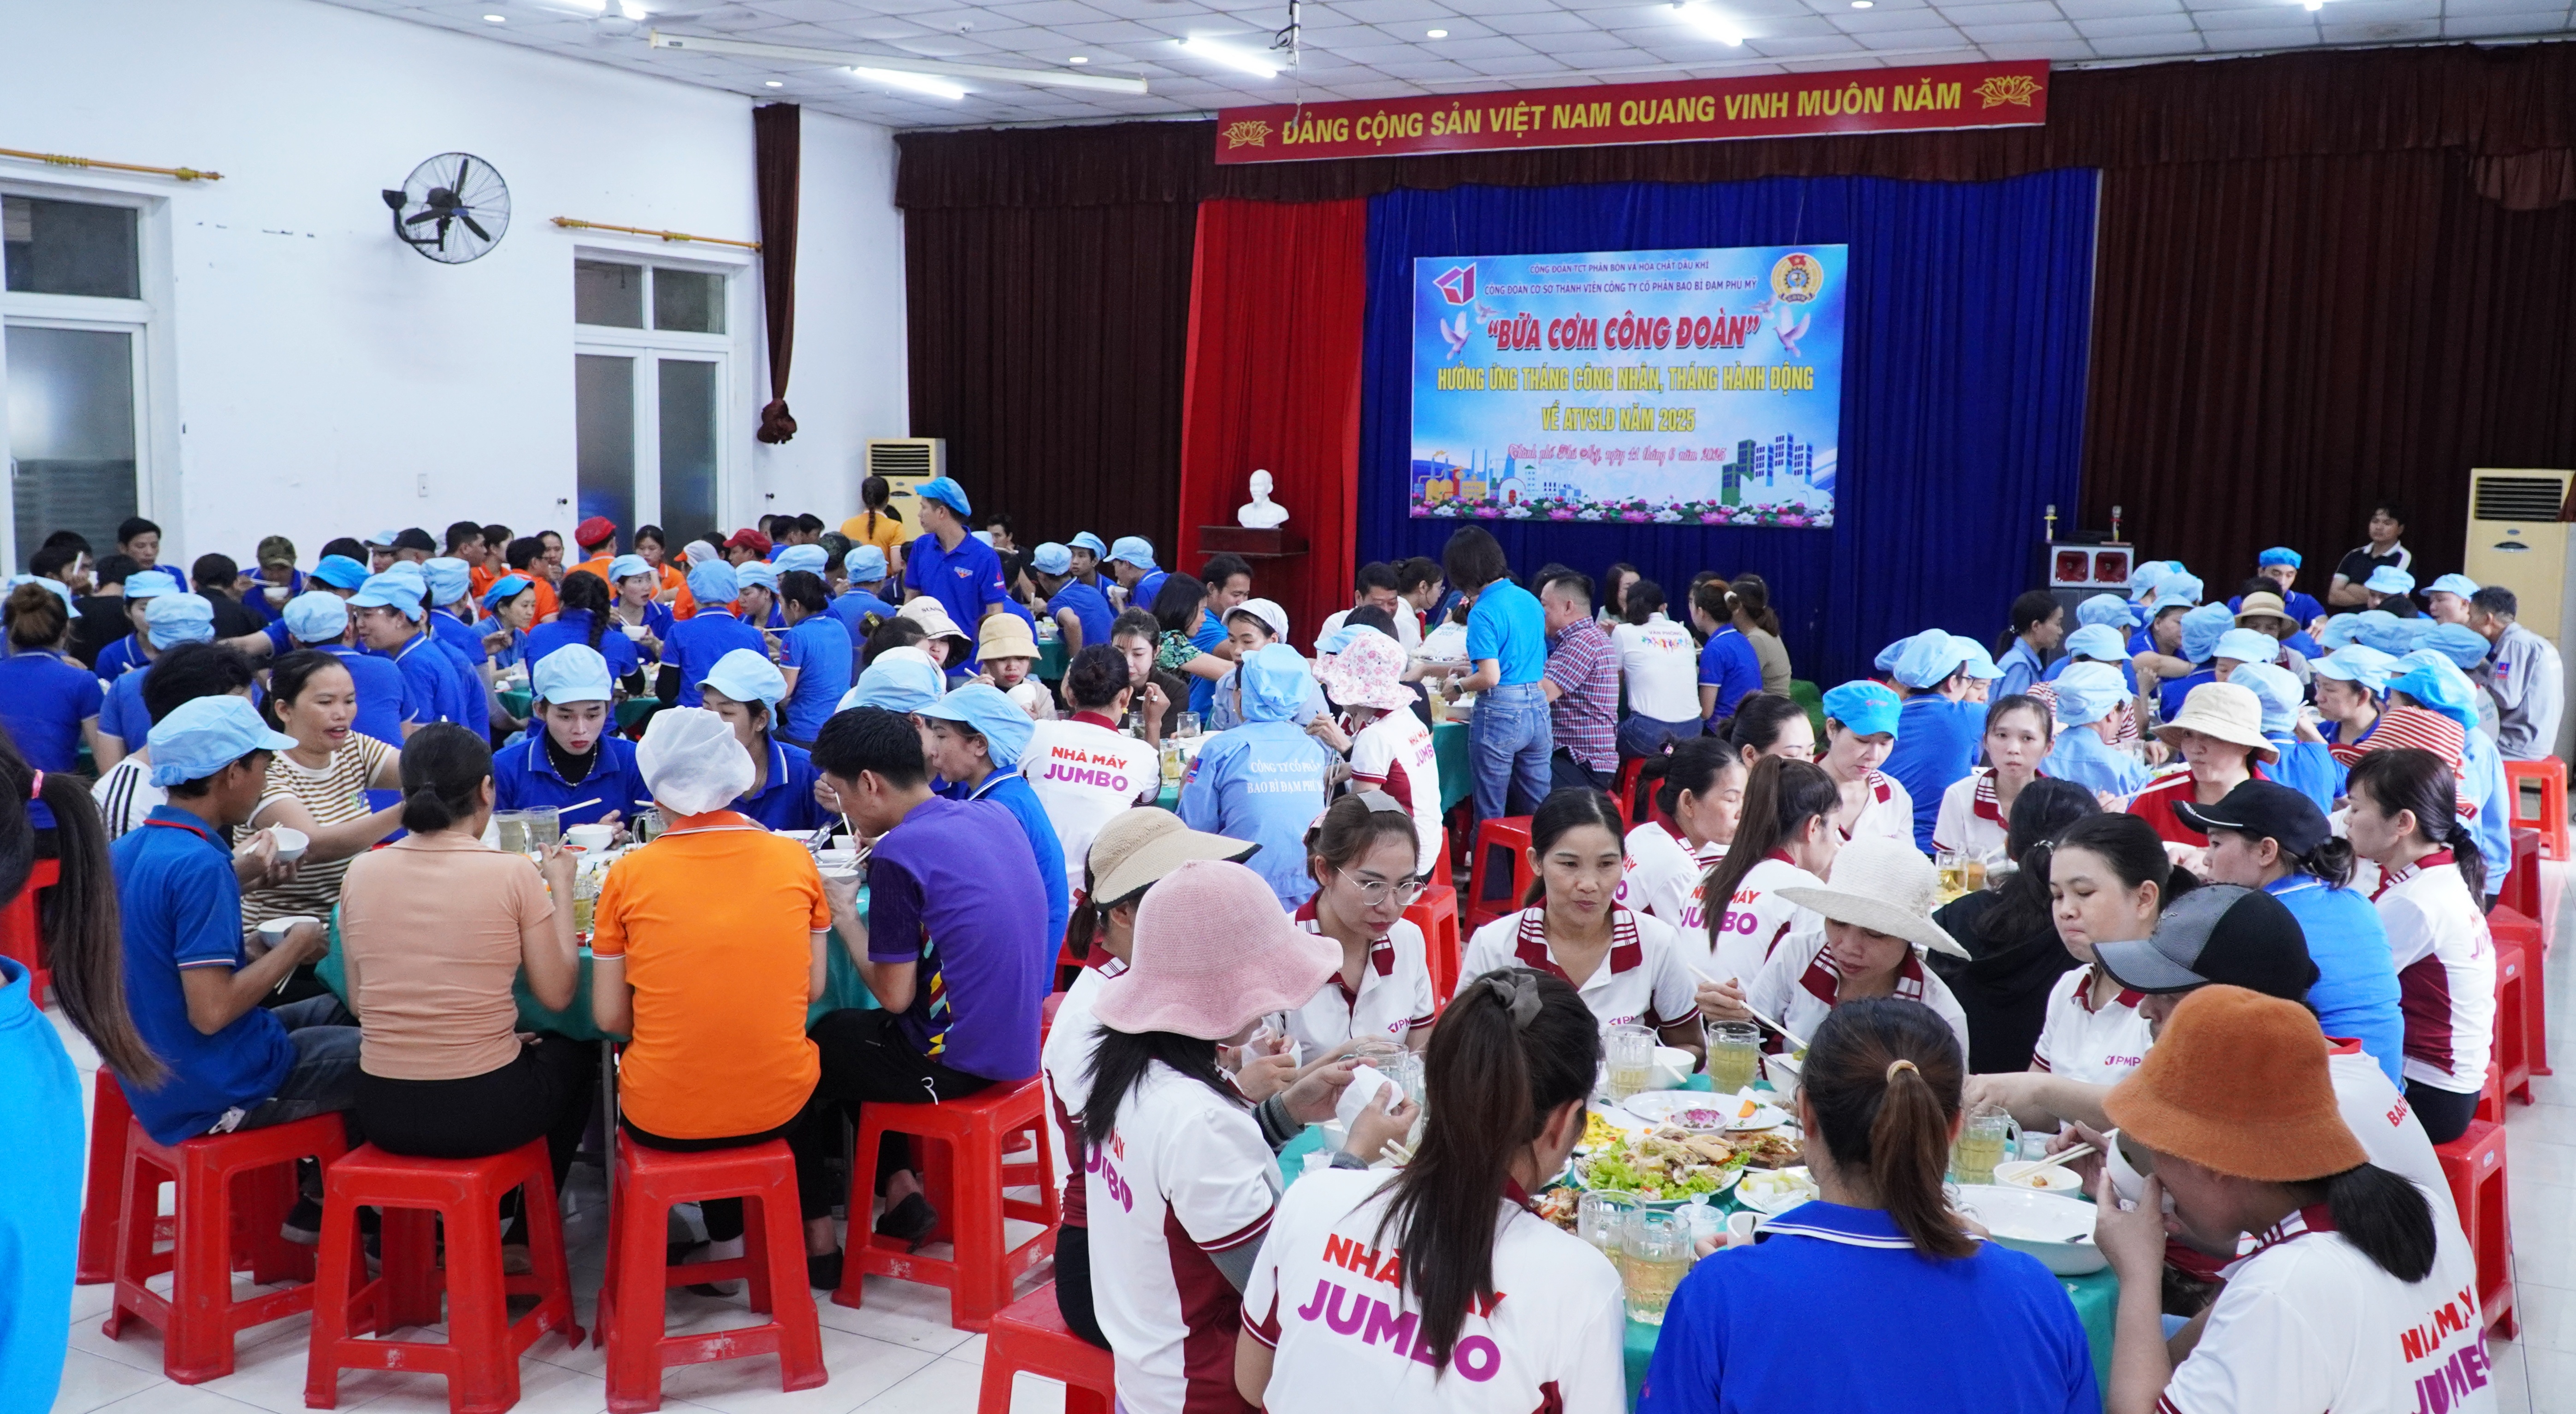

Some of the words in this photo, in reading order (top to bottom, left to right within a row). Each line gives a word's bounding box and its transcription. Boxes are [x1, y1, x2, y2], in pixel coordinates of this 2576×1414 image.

[1282, 112, 1349, 144] ĐẢNG
[1356, 111, 1423, 146] CỘNG
[1430, 102, 1481, 136] SẢN
[1489, 101, 1546, 137] VIỆT
[1552, 102, 1611, 130] NAM
[1619, 95, 1715, 126] QUANG
[1724, 92, 1788, 120] VINH
[1797, 82, 1884, 117] MUÔN
[1893, 77, 1962, 111] NĂM
[1530, 262, 1549, 273] CÔNG
[1574, 264, 1586, 272] TCT
[1484, 283, 1505, 295] CÔNG
[1583, 281, 1601, 293] VIÊN
[1604, 280, 1625, 292] CÔNG
[1628, 283, 1637, 292] TY
[1676, 281, 1692, 290] BAO
[1706, 280, 1723, 292] ĐẠM
[1548, 312, 1599, 350] CƠM
[1604, 309, 1672, 349] CÔNG
[1437, 361, 1485, 390] HƯỞNG
[1489, 362, 1518, 390] ỨNG
[1522, 362, 1569, 390] THÁNG
[1573, 362, 1613, 390] CÔNG
[1617, 361, 1663, 393] NHÂN,
[1668, 361, 1718, 390] THÁNG
[1722, 361, 1766, 390] HÀNH
[1770, 361, 1814, 396] ĐỘNG
[1563, 407, 1614, 431] ATVSLĐ
[1619, 402, 1654, 432] NĂM
[1658, 408, 1696, 432] 2025
[1052, 746, 1087, 763] NHÀ
[1092, 754, 1128, 769] MÁY
[1250, 759, 1276, 773] CÔNG
[1277, 762, 1288, 772] TY
[1415, 743, 1434, 767] JUMB
[1044, 763, 1128, 791] JUMBO
[1247, 781, 1268, 793] BAO
[1269, 778, 1280, 793] BÌ
[1280, 781, 1301, 793] ĐẠM
[1682, 906, 1758, 935] JUBO
[1398, 1016, 1411, 1029] PM
[2115, 1056, 2141, 1066] PMP
[2387, 1098, 2407, 1127] BAO
